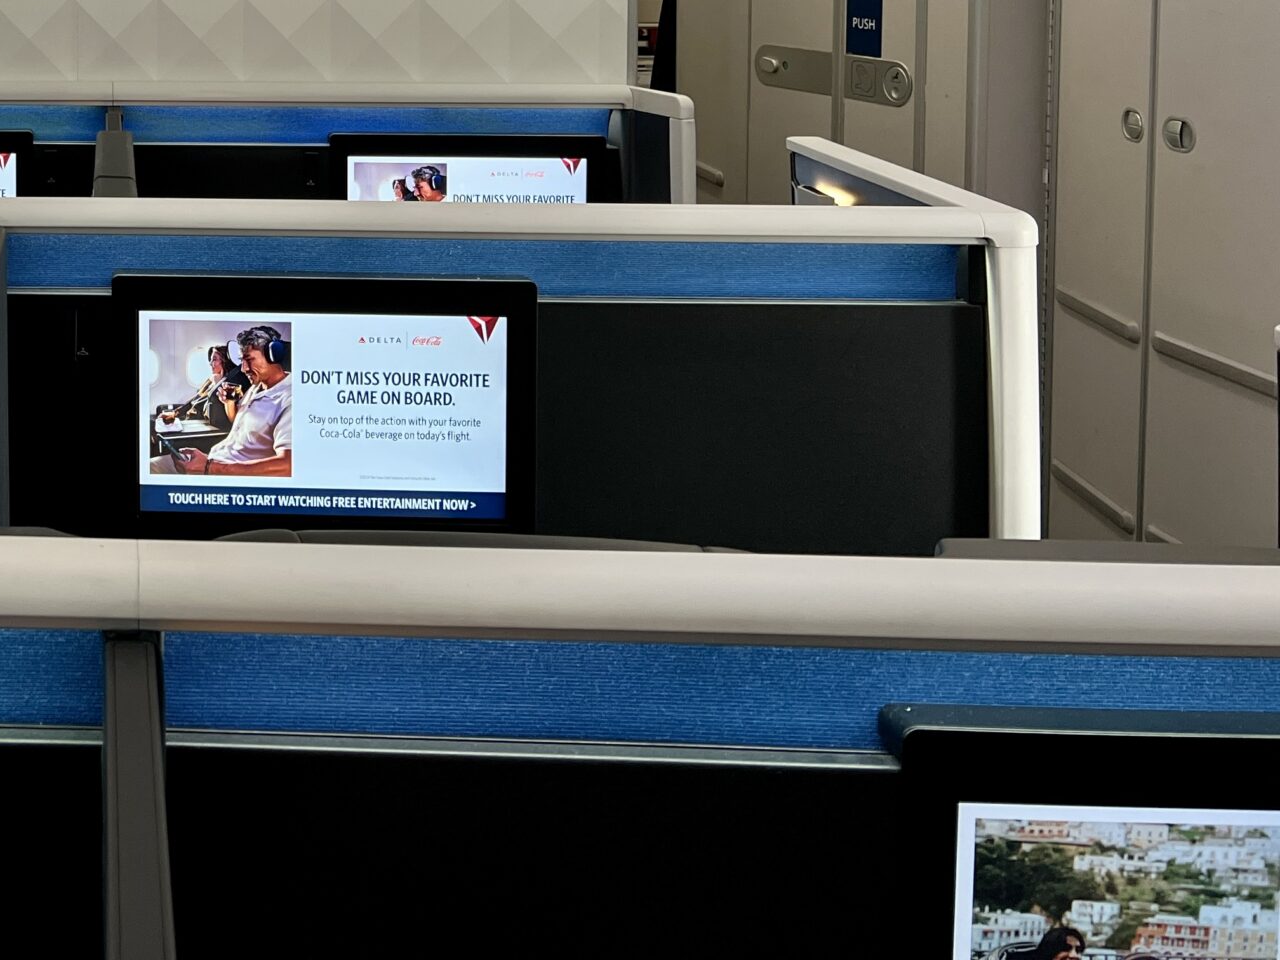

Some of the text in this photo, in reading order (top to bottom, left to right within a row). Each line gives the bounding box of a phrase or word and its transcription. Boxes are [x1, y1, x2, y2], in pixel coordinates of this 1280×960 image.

[852, 17, 875, 30] PUSH
[453, 194, 575, 204] DON'T MISS YOUR FAVORITE
[301, 370, 490, 388] DON'T MISS YOUR FAVORITE
[337, 390, 455, 406] GAME ON BOARD.
[308, 414, 326, 425] Stay
[340, 416, 353, 426] top
[356, 415, 364, 425] of
[366, 416, 379, 425] the
[381, 416, 406, 425] action
[409, 417, 427, 426] with
[429, 419, 446, 428] your
[449, 417, 481, 427] favorite
[365, 430, 402, 441] beverage
[417, 431, 445, 442] today's
[448, 432, 471, 442] flight.
[168, 493, 468, 510] TOUCH HERE TO START WATCHING FREE ENTERTAINMENT NOW
